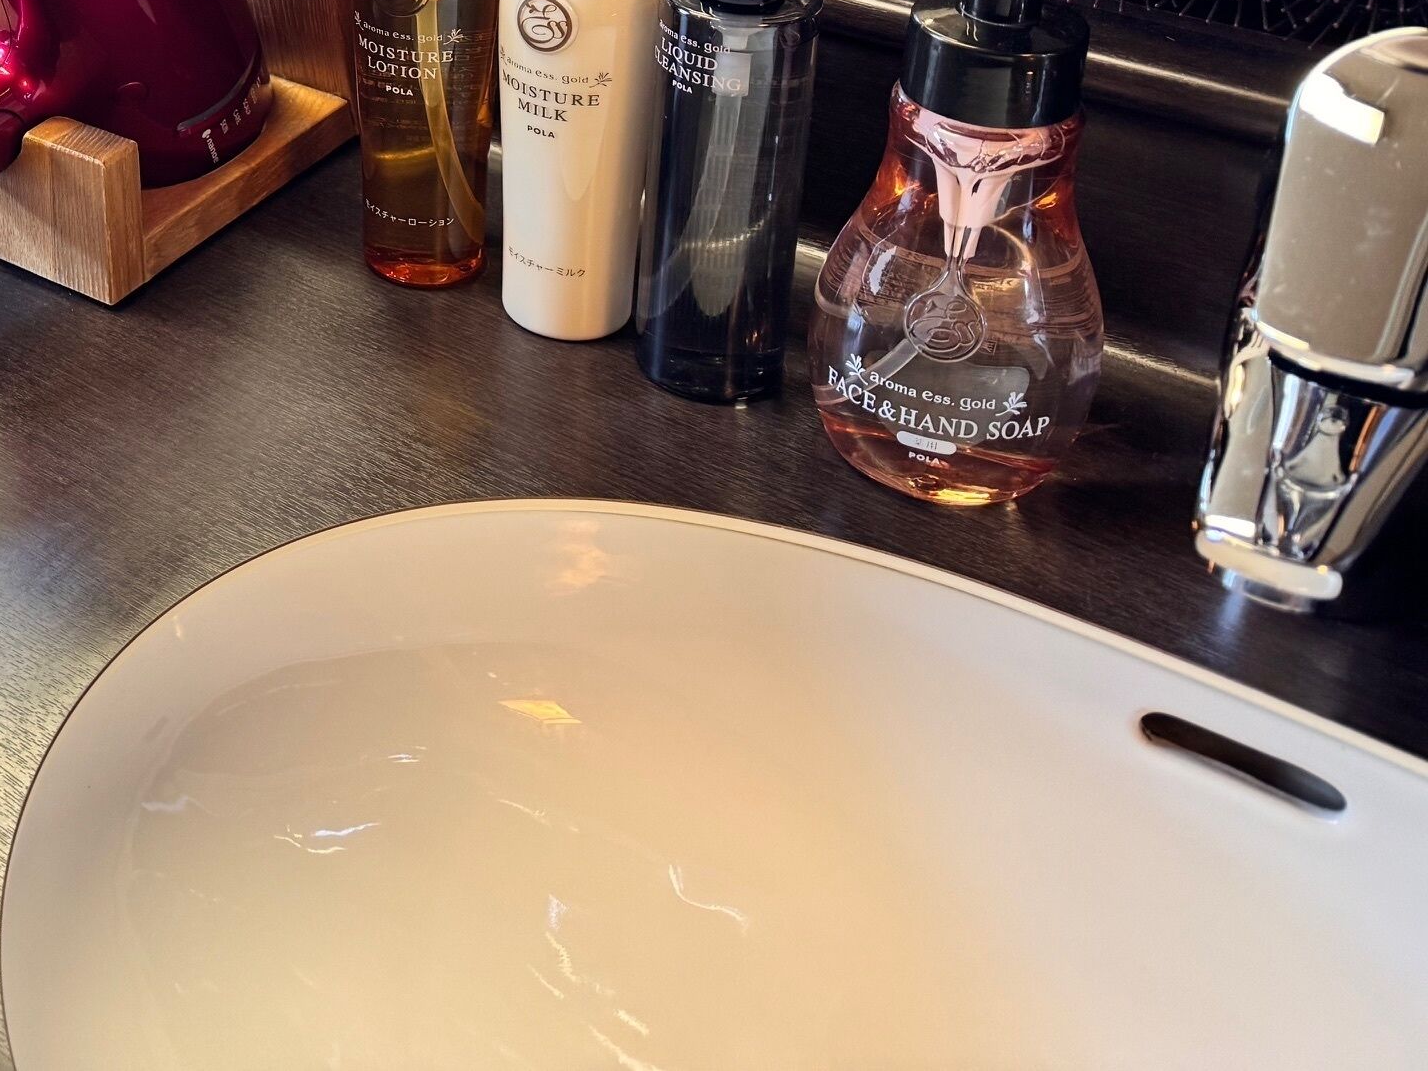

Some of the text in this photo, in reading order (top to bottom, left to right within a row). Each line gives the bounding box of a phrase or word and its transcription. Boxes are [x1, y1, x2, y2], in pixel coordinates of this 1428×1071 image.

[363, 21, 390, 37] aroma
[418, 34, 443, 44] gold
[358, 34, 454, 63] MOISTURE
[661, 37, 718, 71] LIQUID
[704, 42, 731, 54] gold
[368, 55, 437, 80] LOTION
[507, 56, 532, 74] aroma
[561, 75, 589, 85] gold
[654, 45, 742, 92] CLEANSING
[385, 85, 414, 97] POLA
[502, 69, 600, 107] MOISTURE
[672, 79, 693, 94] POLA
[518, 97, 568, 122] MILK
[527, 125, 555, 139] POLA
[365, 198, 455, 227] モイスチャーローション
[508, 245, 586, 277] モイスチャーミルク
[869, 371, 996, 411] aroma ess. gold
[986, 416, 1051, 441] SOAP
[908, 451, 941, 466] POLA
